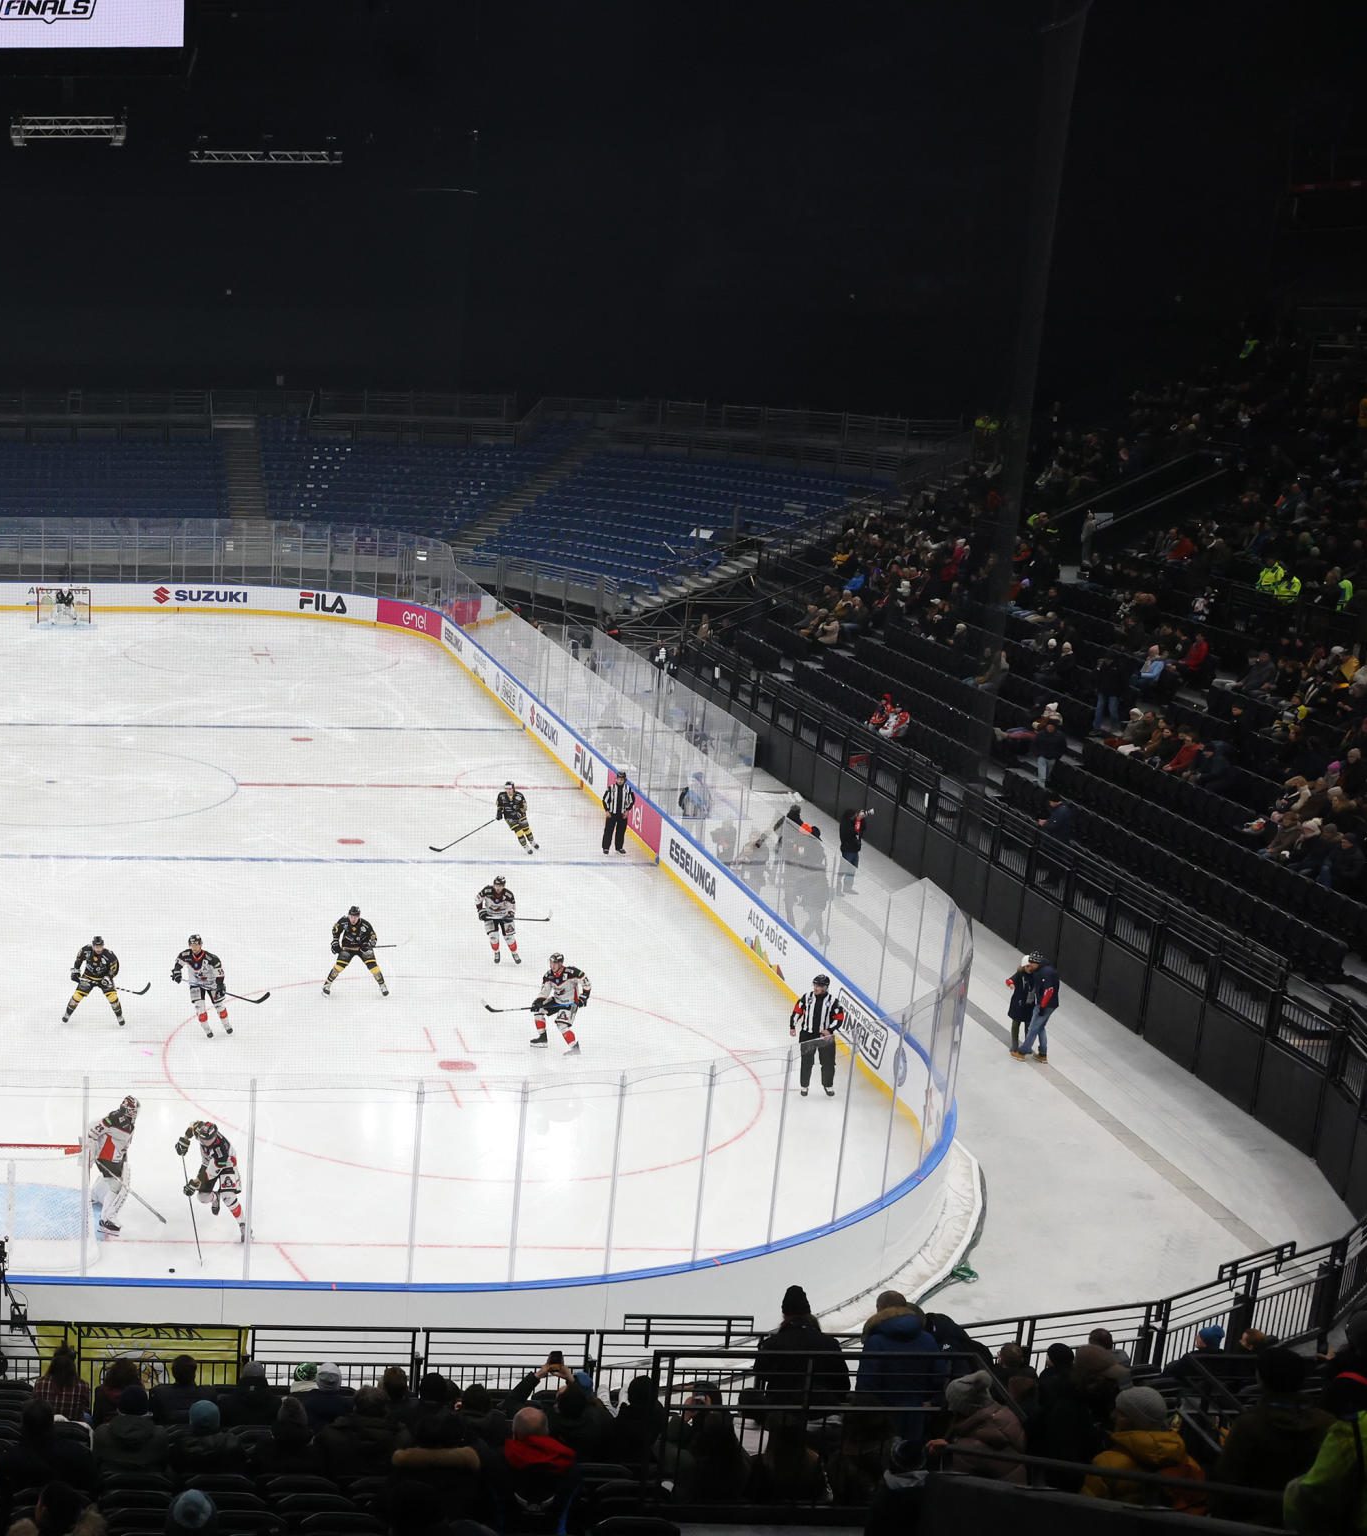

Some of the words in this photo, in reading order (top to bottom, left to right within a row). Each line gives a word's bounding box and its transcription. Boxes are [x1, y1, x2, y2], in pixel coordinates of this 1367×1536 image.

[3, 0, 89, 15] FINALS
[174, 590, 248, 603] SUZUKI
[299, 592, 347, 614] FILA
[402, 610, 427, 630] enel
[535, 713, 559, 746] SUZUKI
[574, 743, 594, 785] FILA
[669, 838, 716, 900] ESSELUNGA
[841, 995, 861, 1020] MILANO
[842, 1009, 882, 1060] INALS
